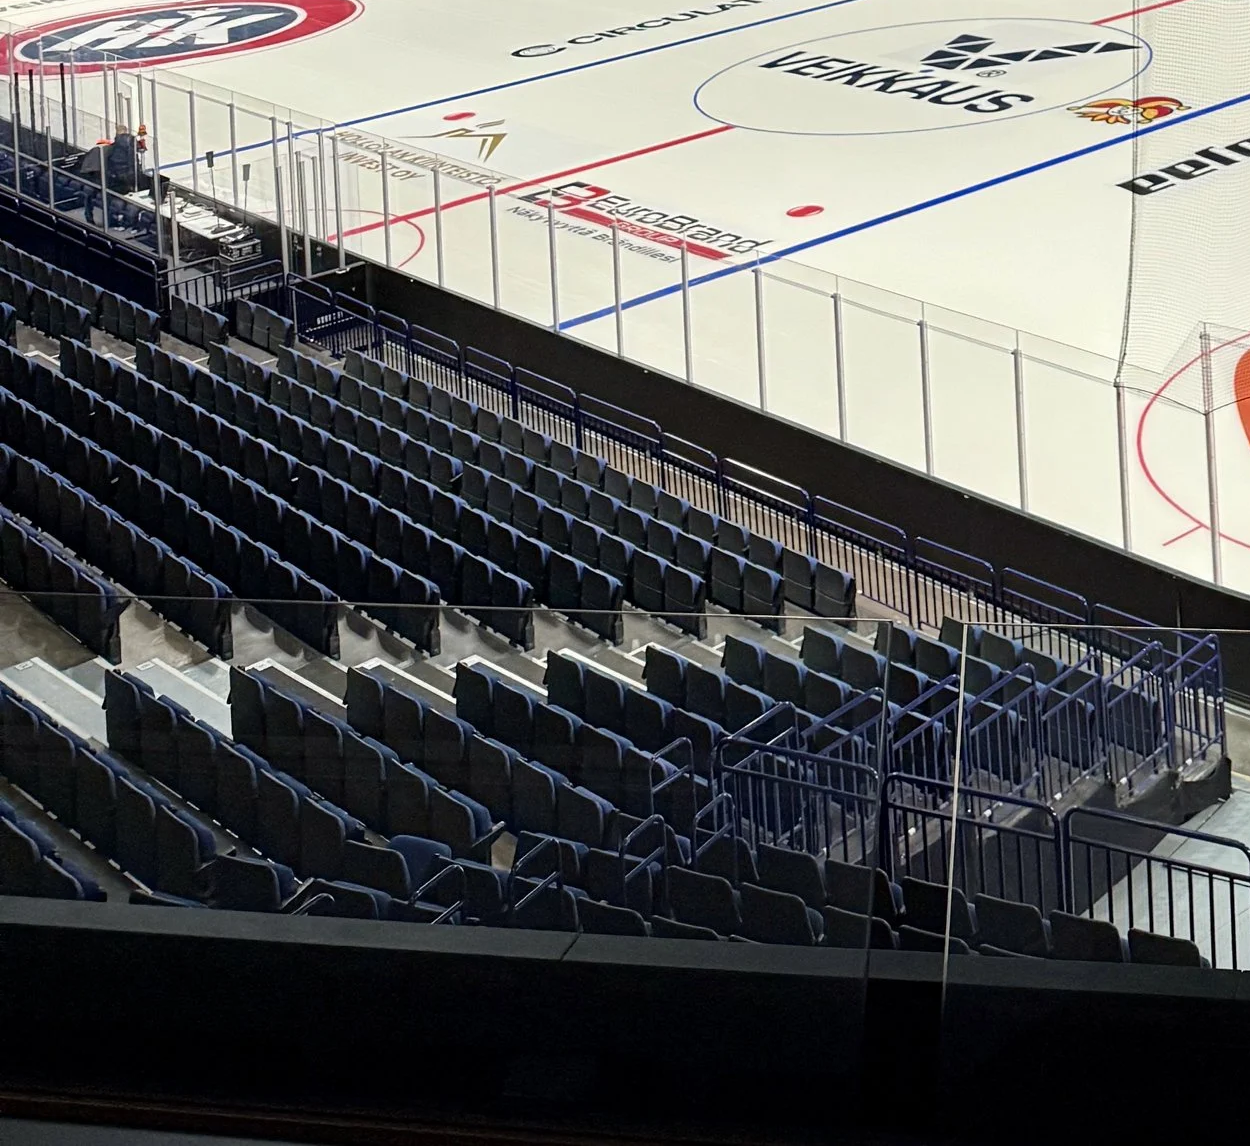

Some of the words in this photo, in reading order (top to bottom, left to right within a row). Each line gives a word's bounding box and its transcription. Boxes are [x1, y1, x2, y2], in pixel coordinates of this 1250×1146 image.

[758, 50, 1035, 114] VEIKKAUS
[392, 167, 427, 182] OY
[586, 195, 775, 255] EuroBrand
[614, 221, 680, 245] GROUP
